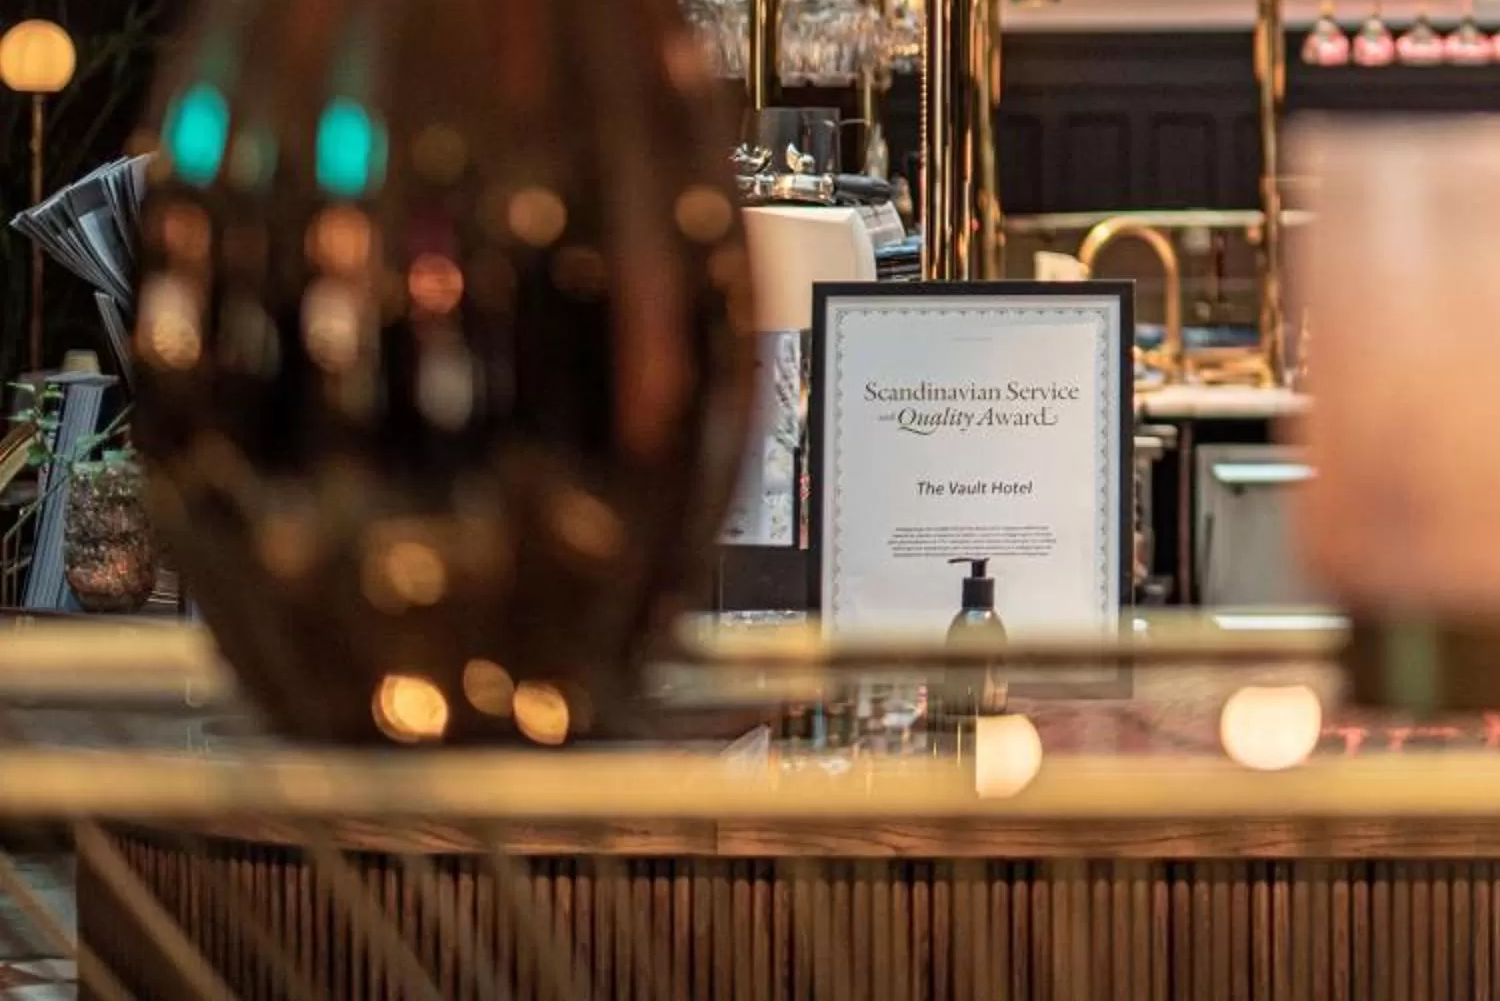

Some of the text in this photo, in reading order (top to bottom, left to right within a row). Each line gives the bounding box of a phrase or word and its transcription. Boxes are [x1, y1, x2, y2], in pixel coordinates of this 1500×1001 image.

[863, 379, 1080, 401] Scandinavian Service
[897, 406, 975, 436] Quality
[976, 406, 1058, 426] Award
[917, 480, 1033, 495] The Vault Hotel
